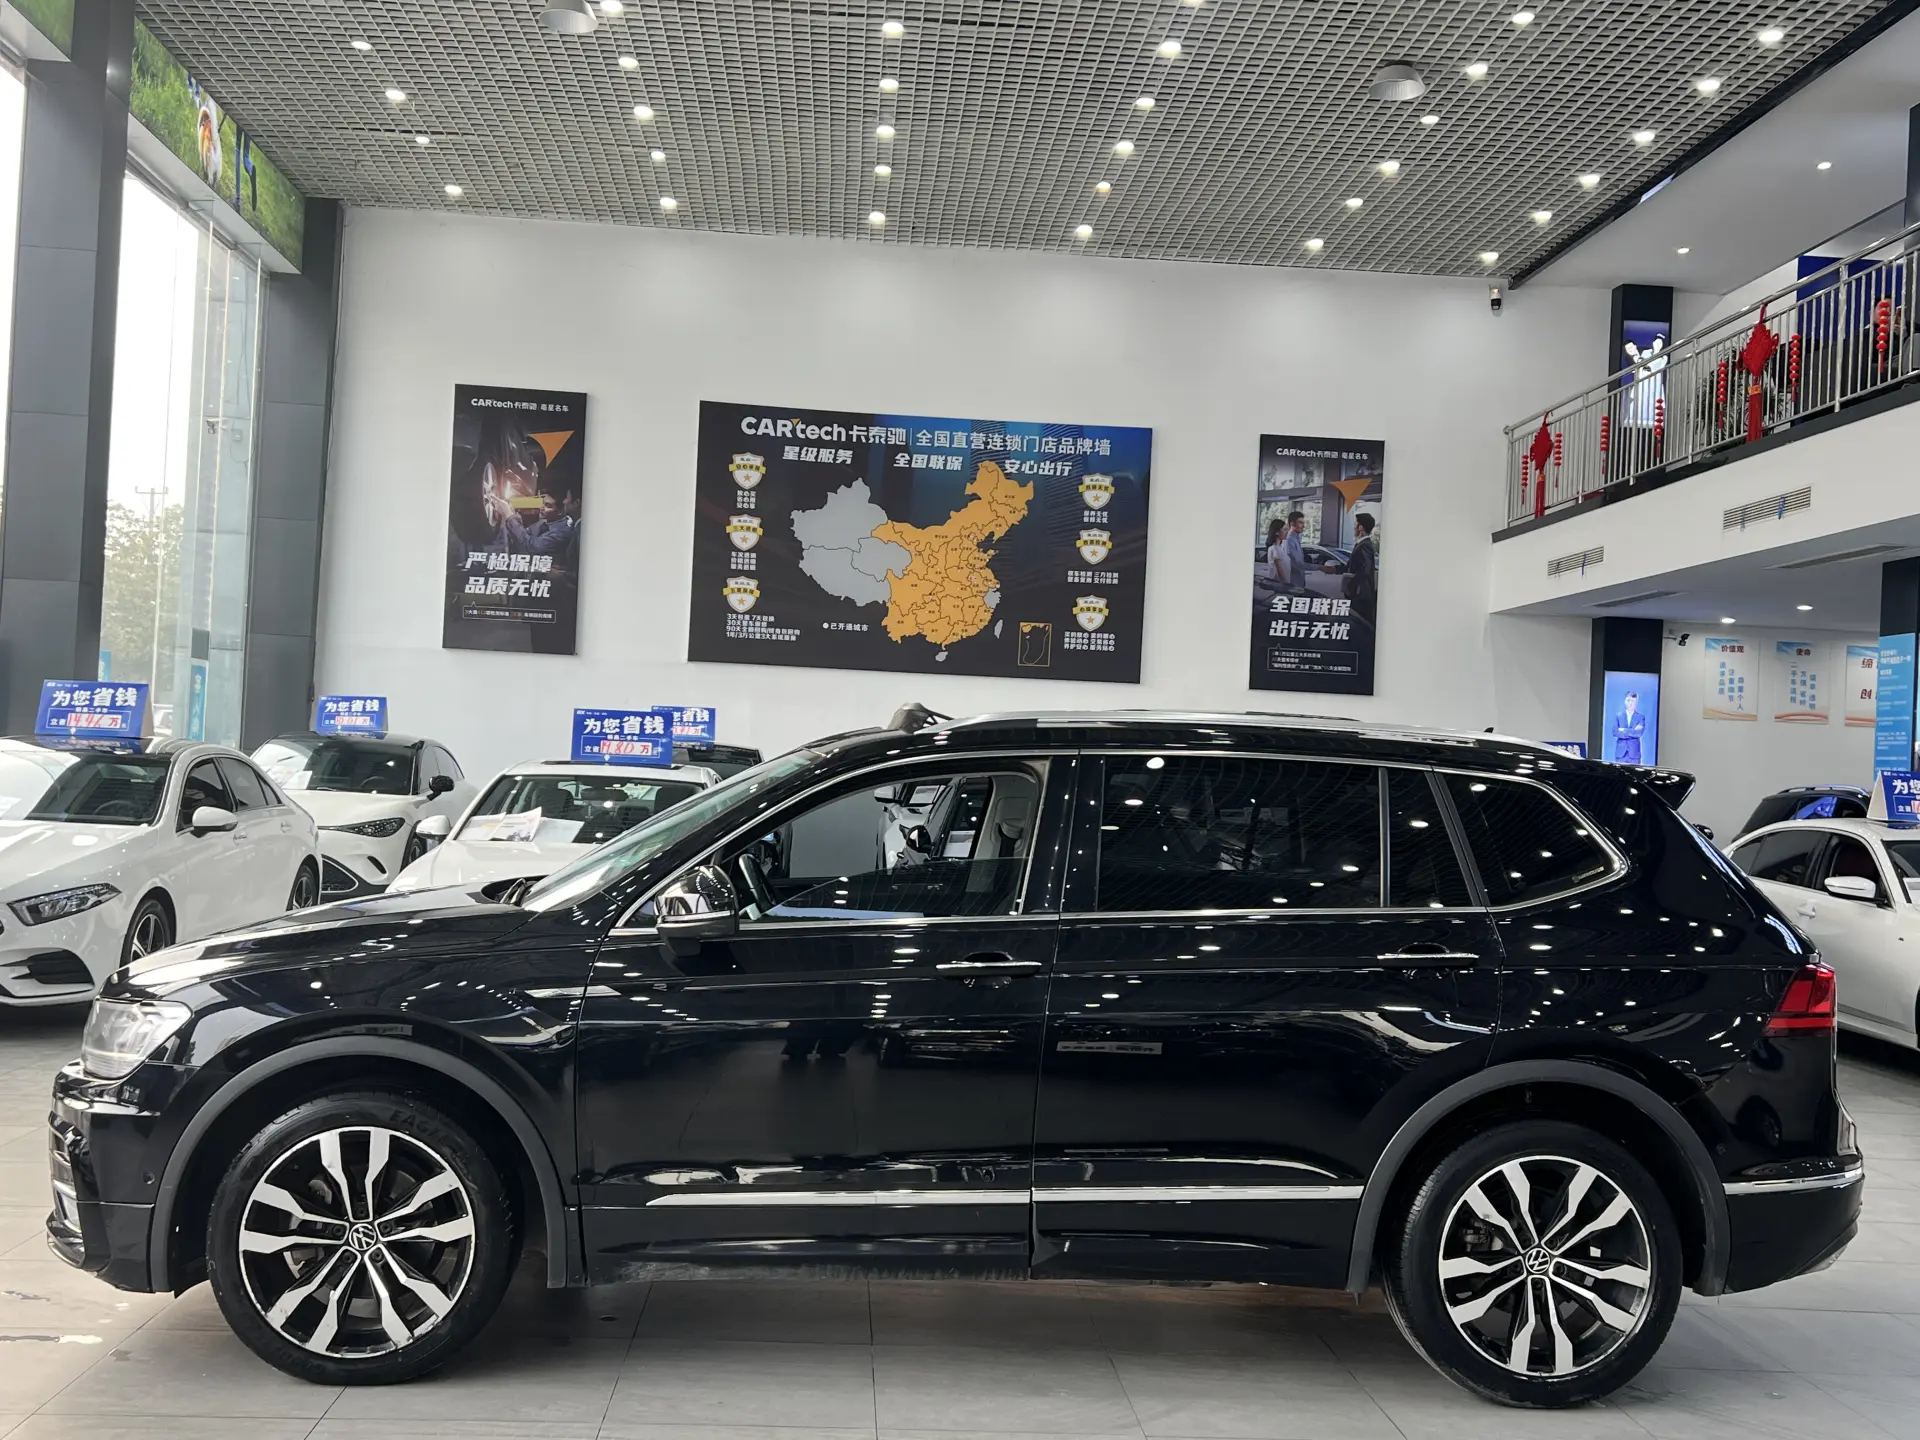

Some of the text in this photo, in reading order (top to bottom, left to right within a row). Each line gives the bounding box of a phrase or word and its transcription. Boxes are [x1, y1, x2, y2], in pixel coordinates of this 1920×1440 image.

[741, 416, 1112, 456] CARtech 卡泰驰 全国直营连锁门店品牌墙
[782, 446, 1072, 477] 星级服务 全国联保 安心出行
[465, 552, 553, 573] 严检保障
[465, 576, 551, 597] 品质无忧
[1270, 596, 1351, 616] 全国联保
[830, 622, 869, 632] 已开通城市
[1269, 619, 1350, 640] 出行无忧
[51, 687, 137, 706] 为您省钱
[325, 699, 379, 712] 为您省钱
[583, 715, 665, 734] 为您省钱
[673, 708, 709, 722] 您省钱
